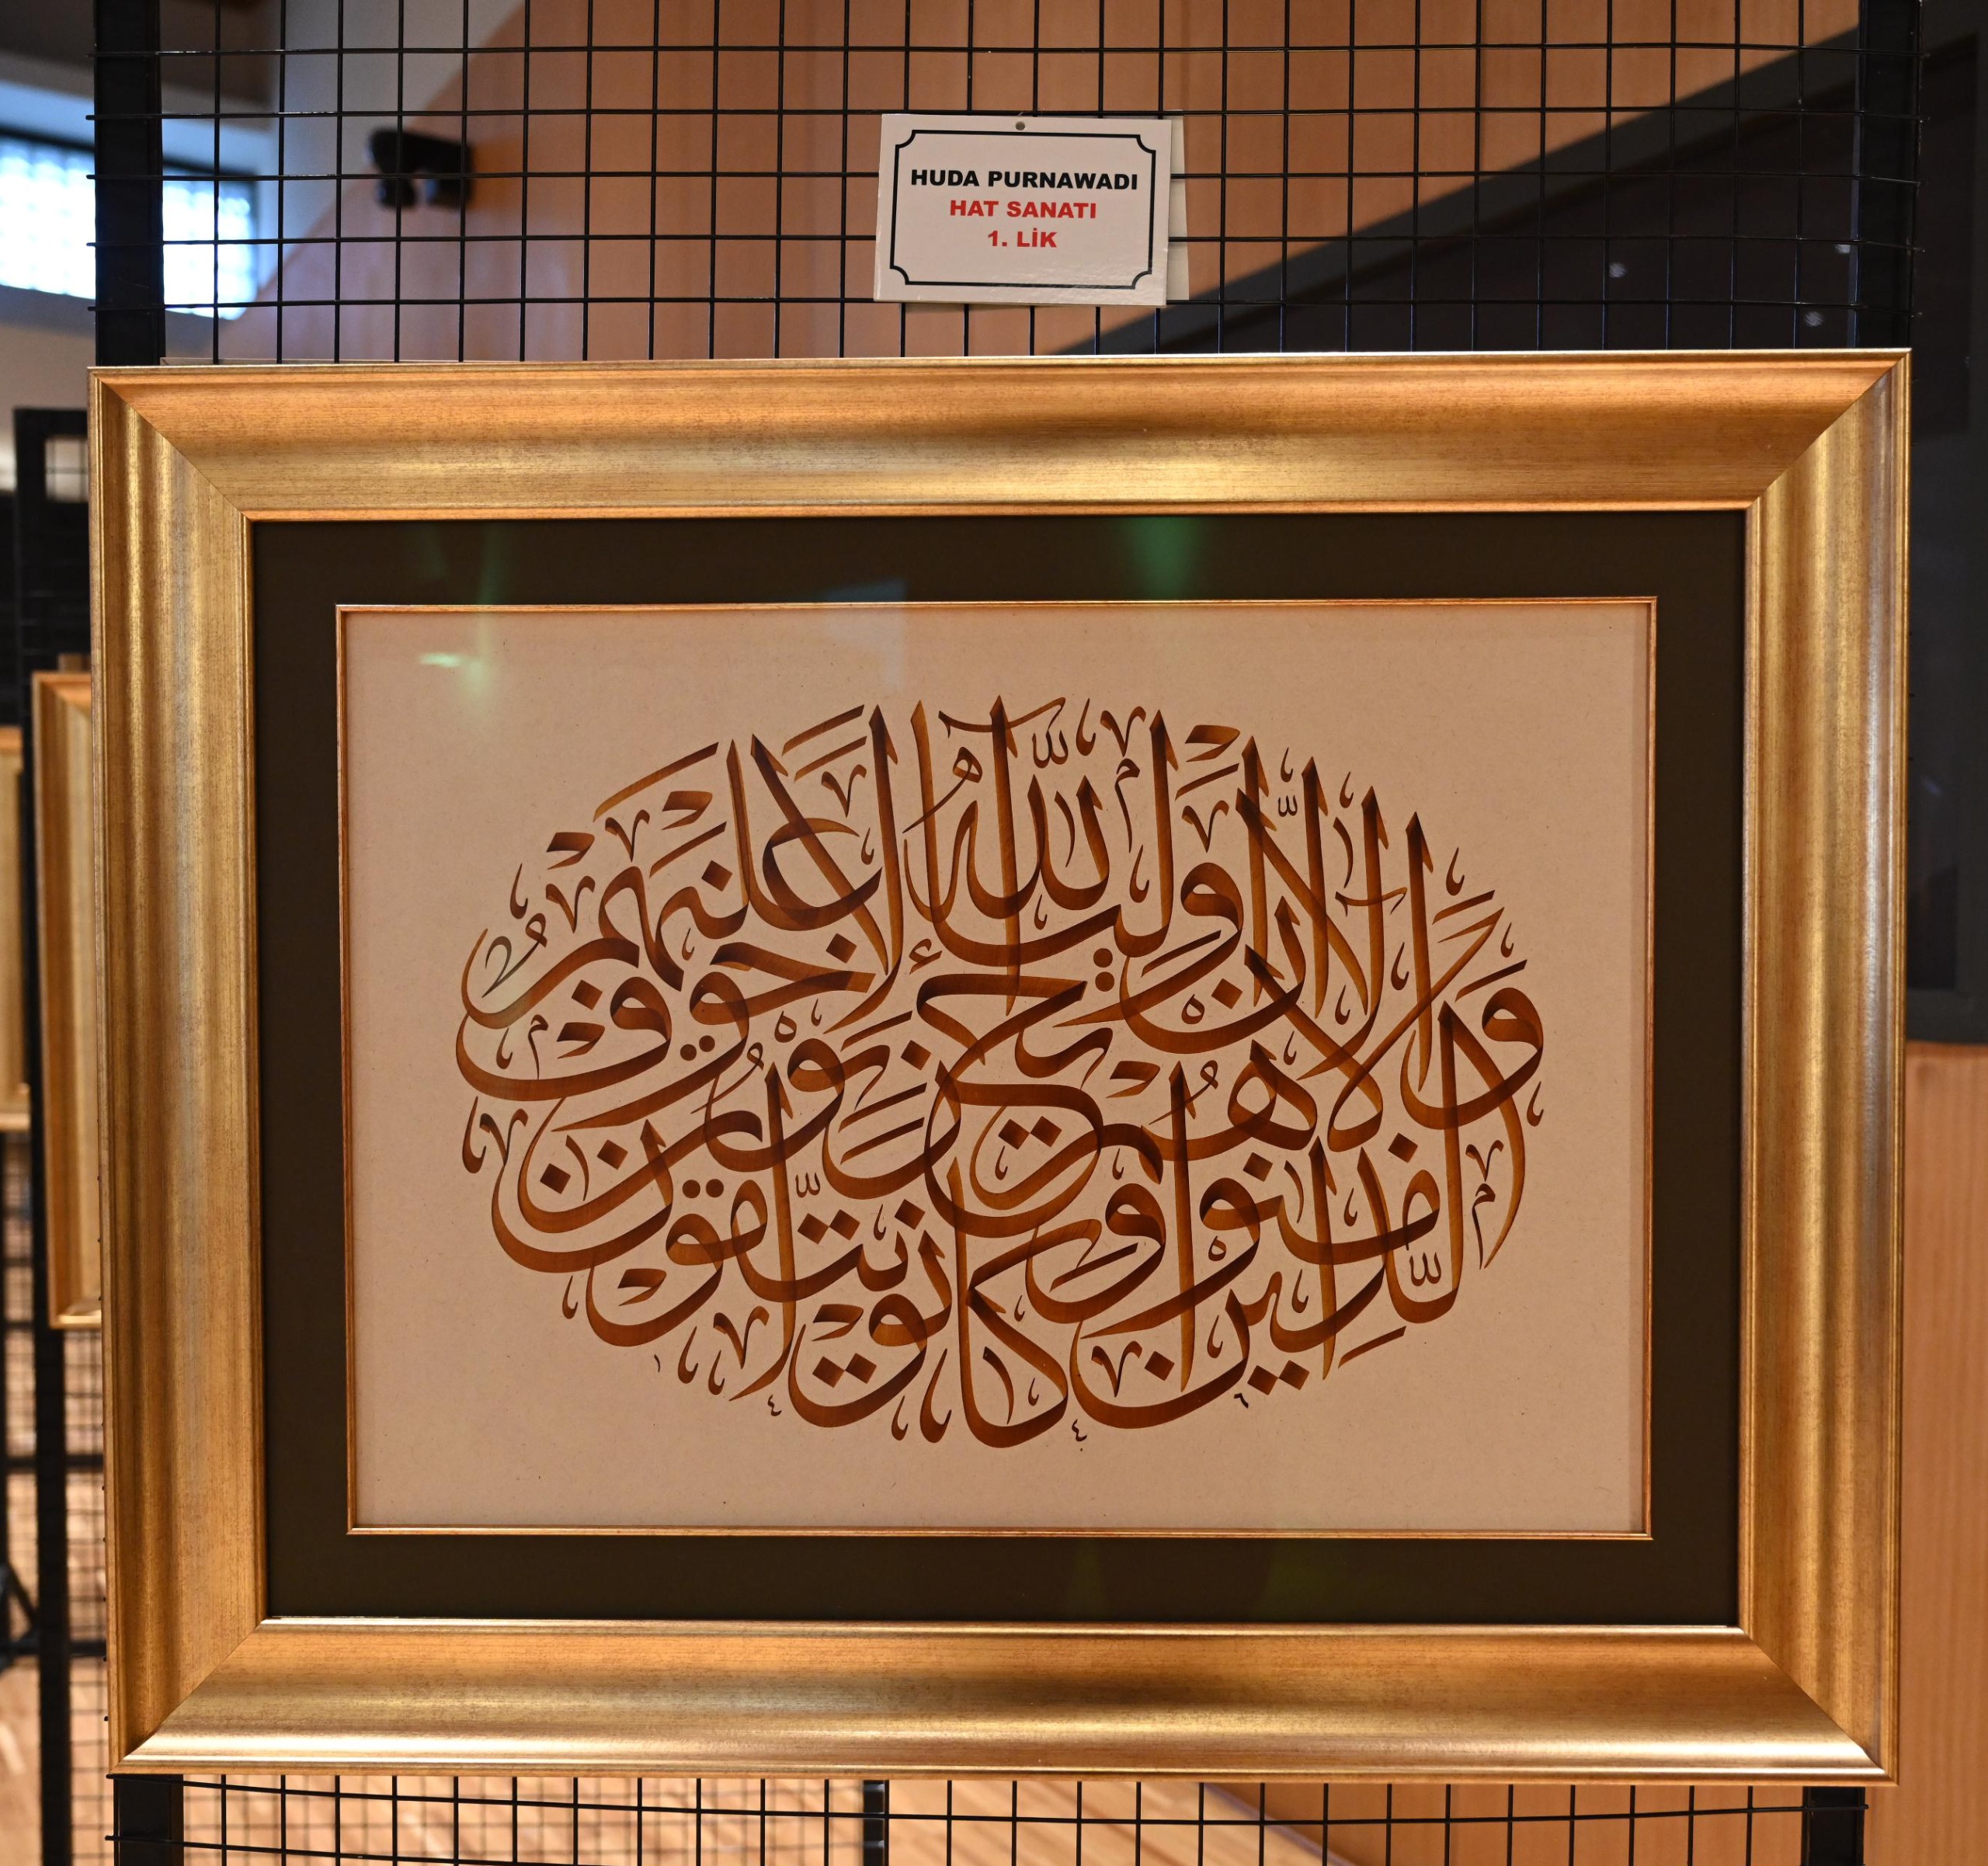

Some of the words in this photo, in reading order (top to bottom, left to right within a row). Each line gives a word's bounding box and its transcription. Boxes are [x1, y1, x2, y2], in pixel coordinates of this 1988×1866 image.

[911, 169, 979, 187] HUDA
[988, 170, 1138, 190] PURNAWADI
[950, 200, 999, 217] HAT
[1006, 200, 1097, 219] SANATI
[987, 230, 1008, 247] 1.
[1017, 228, 1057, 248] LİK
